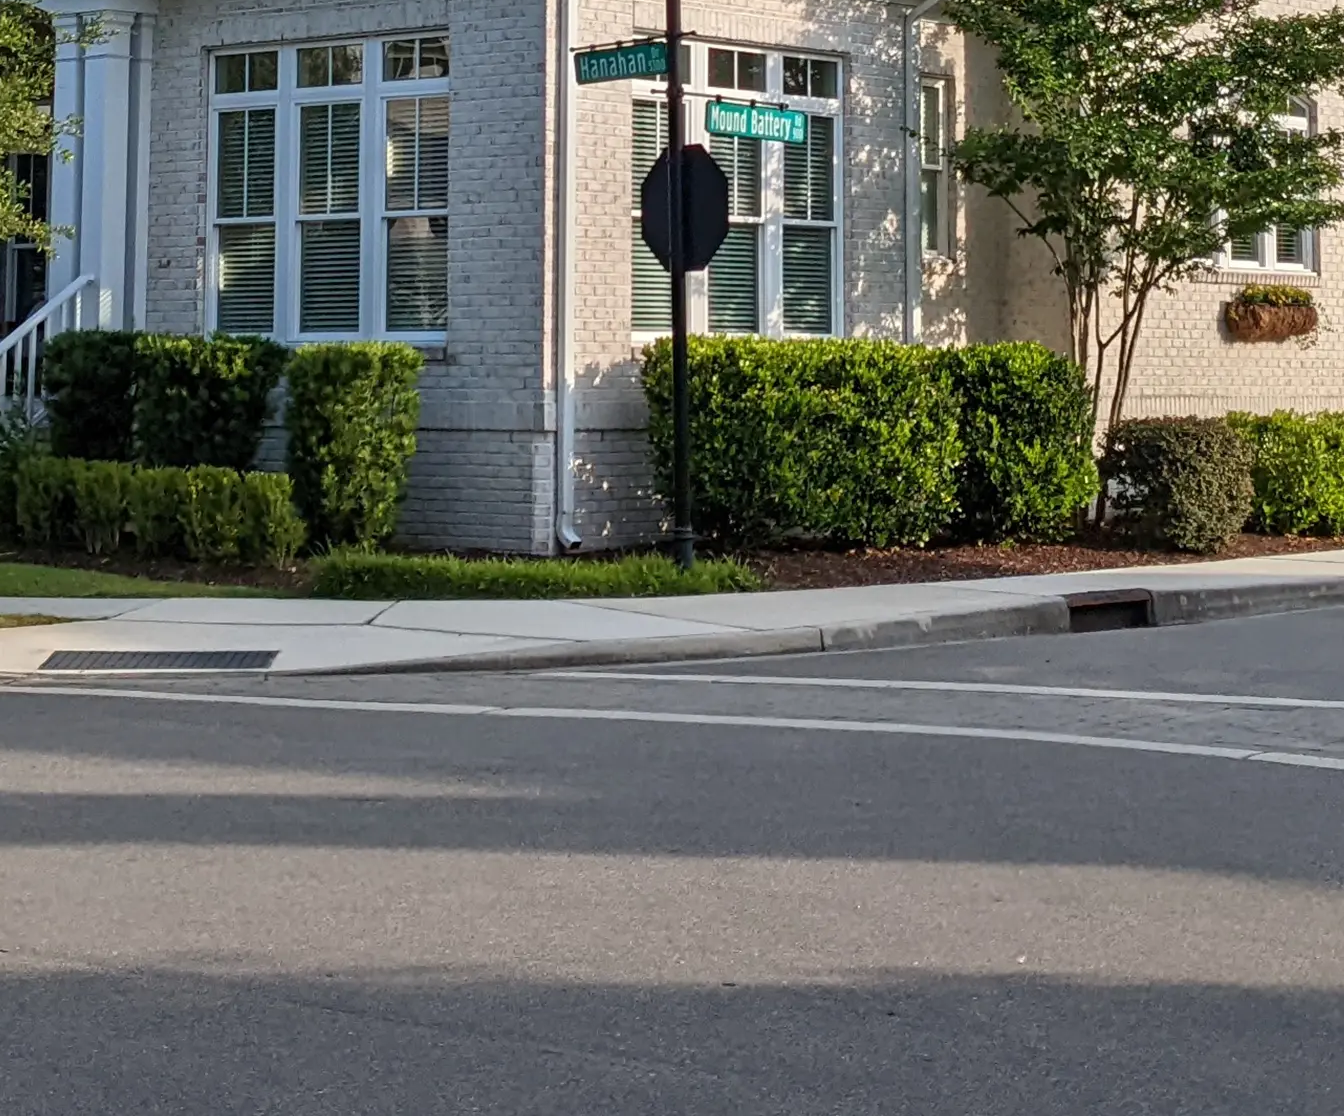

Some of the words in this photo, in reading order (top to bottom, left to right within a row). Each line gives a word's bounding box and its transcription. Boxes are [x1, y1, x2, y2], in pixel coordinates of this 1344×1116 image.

[580, 52, 646, 80] Hanahan
[711, 105, 747, 133] Mound
[751, 110, 791, 140] Battery
